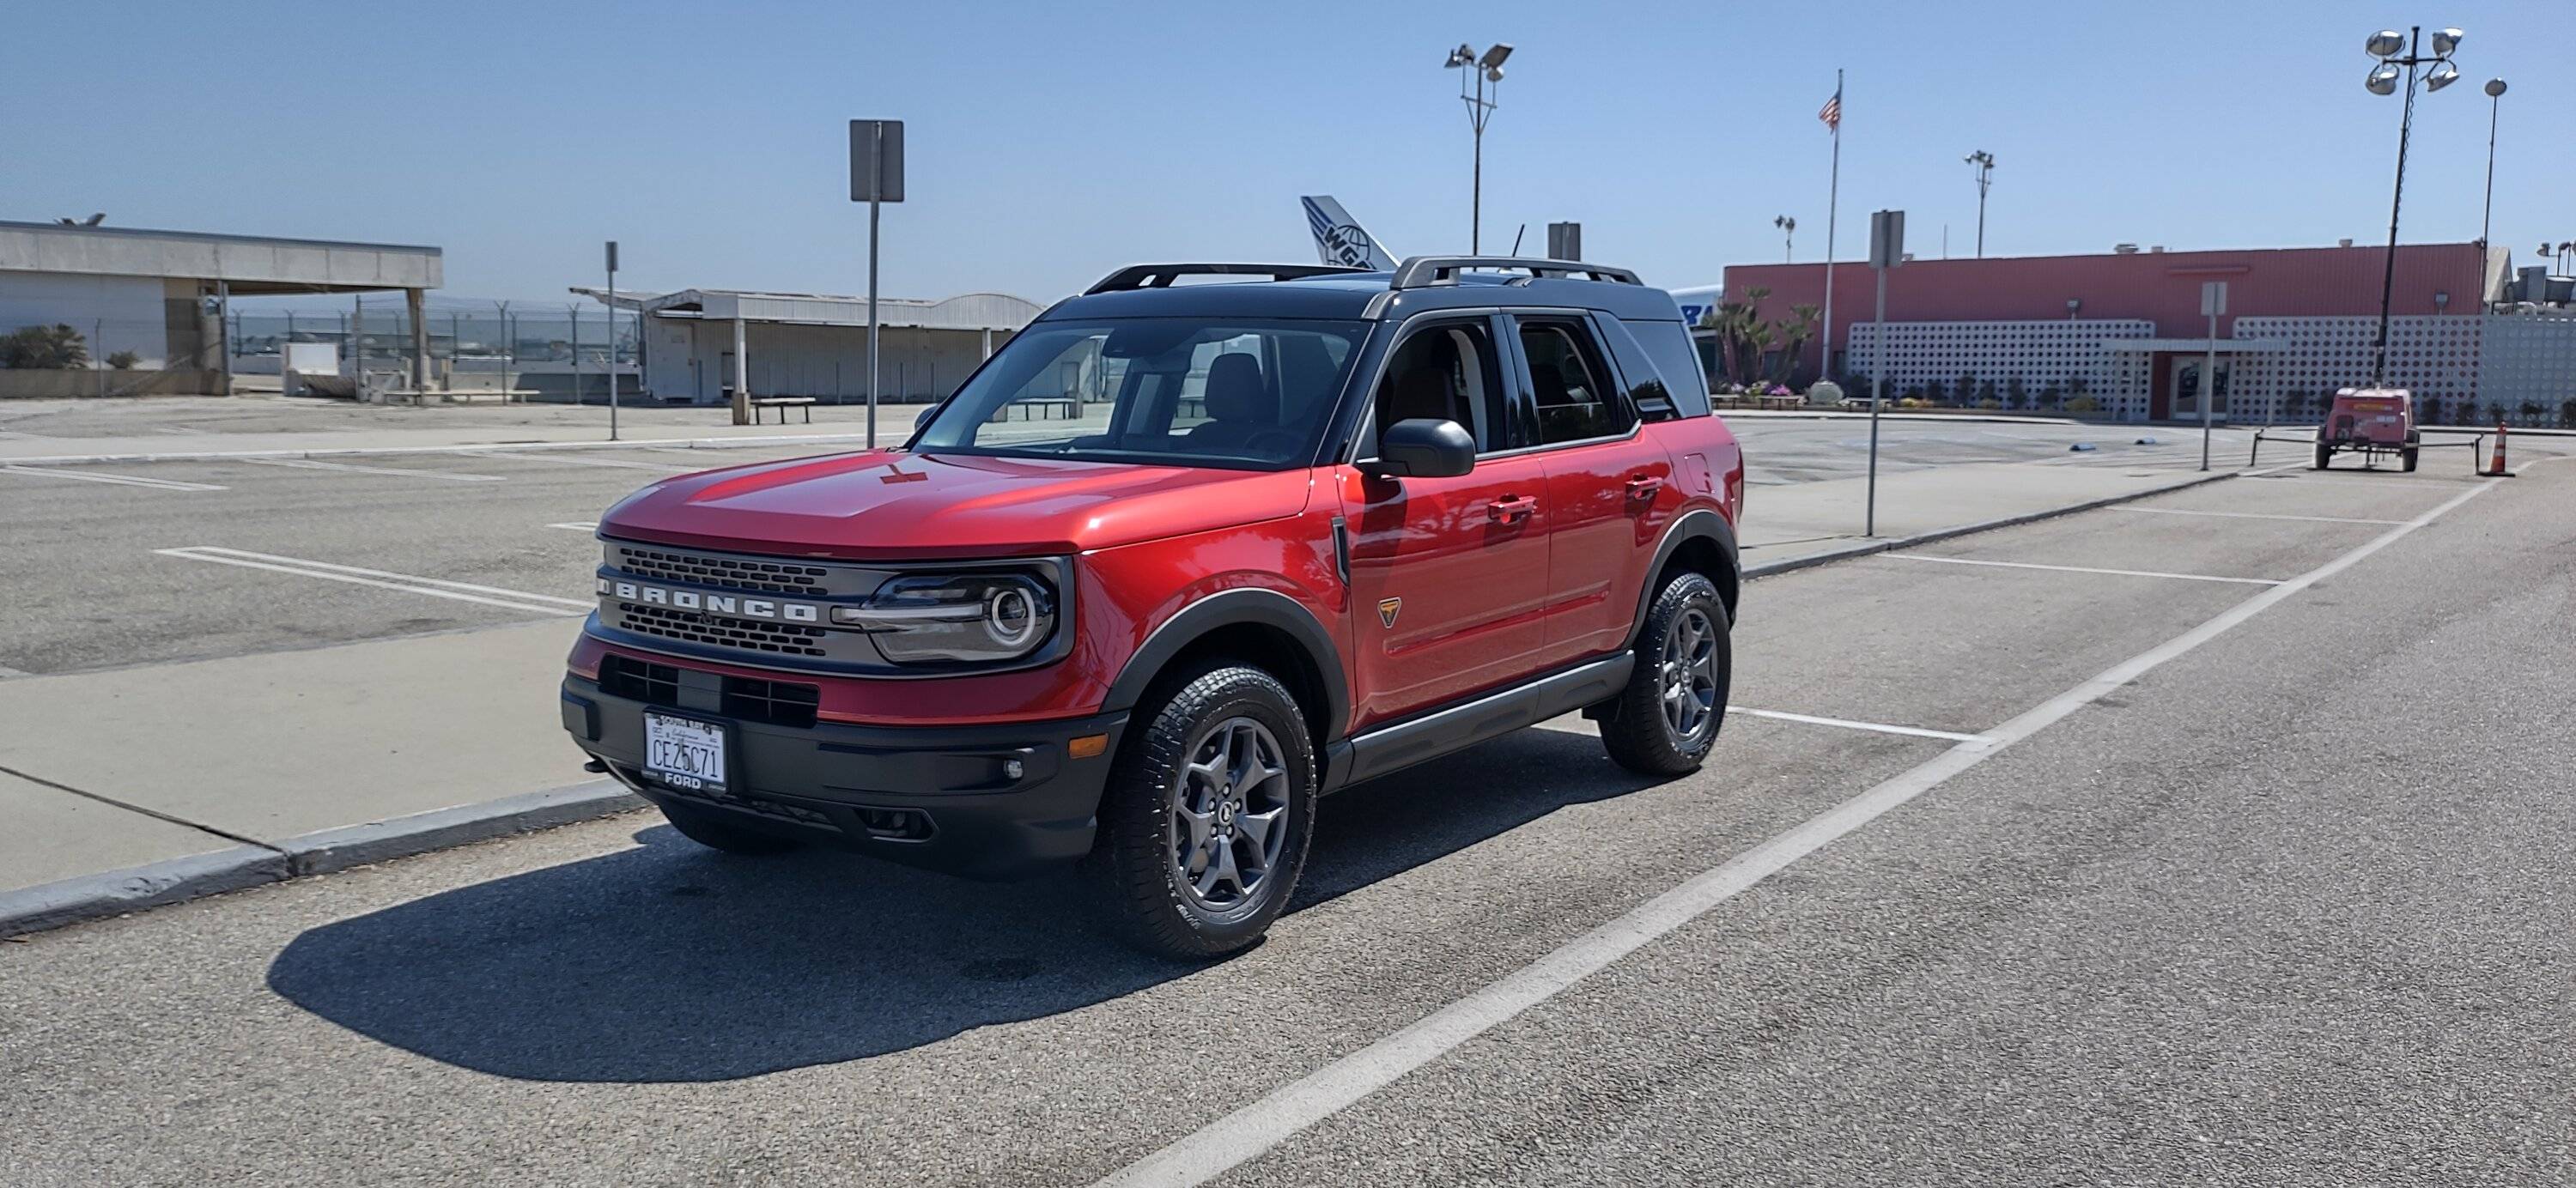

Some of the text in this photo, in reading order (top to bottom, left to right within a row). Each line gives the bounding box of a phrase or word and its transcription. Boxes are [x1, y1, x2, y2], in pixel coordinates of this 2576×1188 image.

[616, 582, 817, 621] BRONCO
[653, 739, 718, 778] CE25C71
[665, 773, 702, 790] FORD
